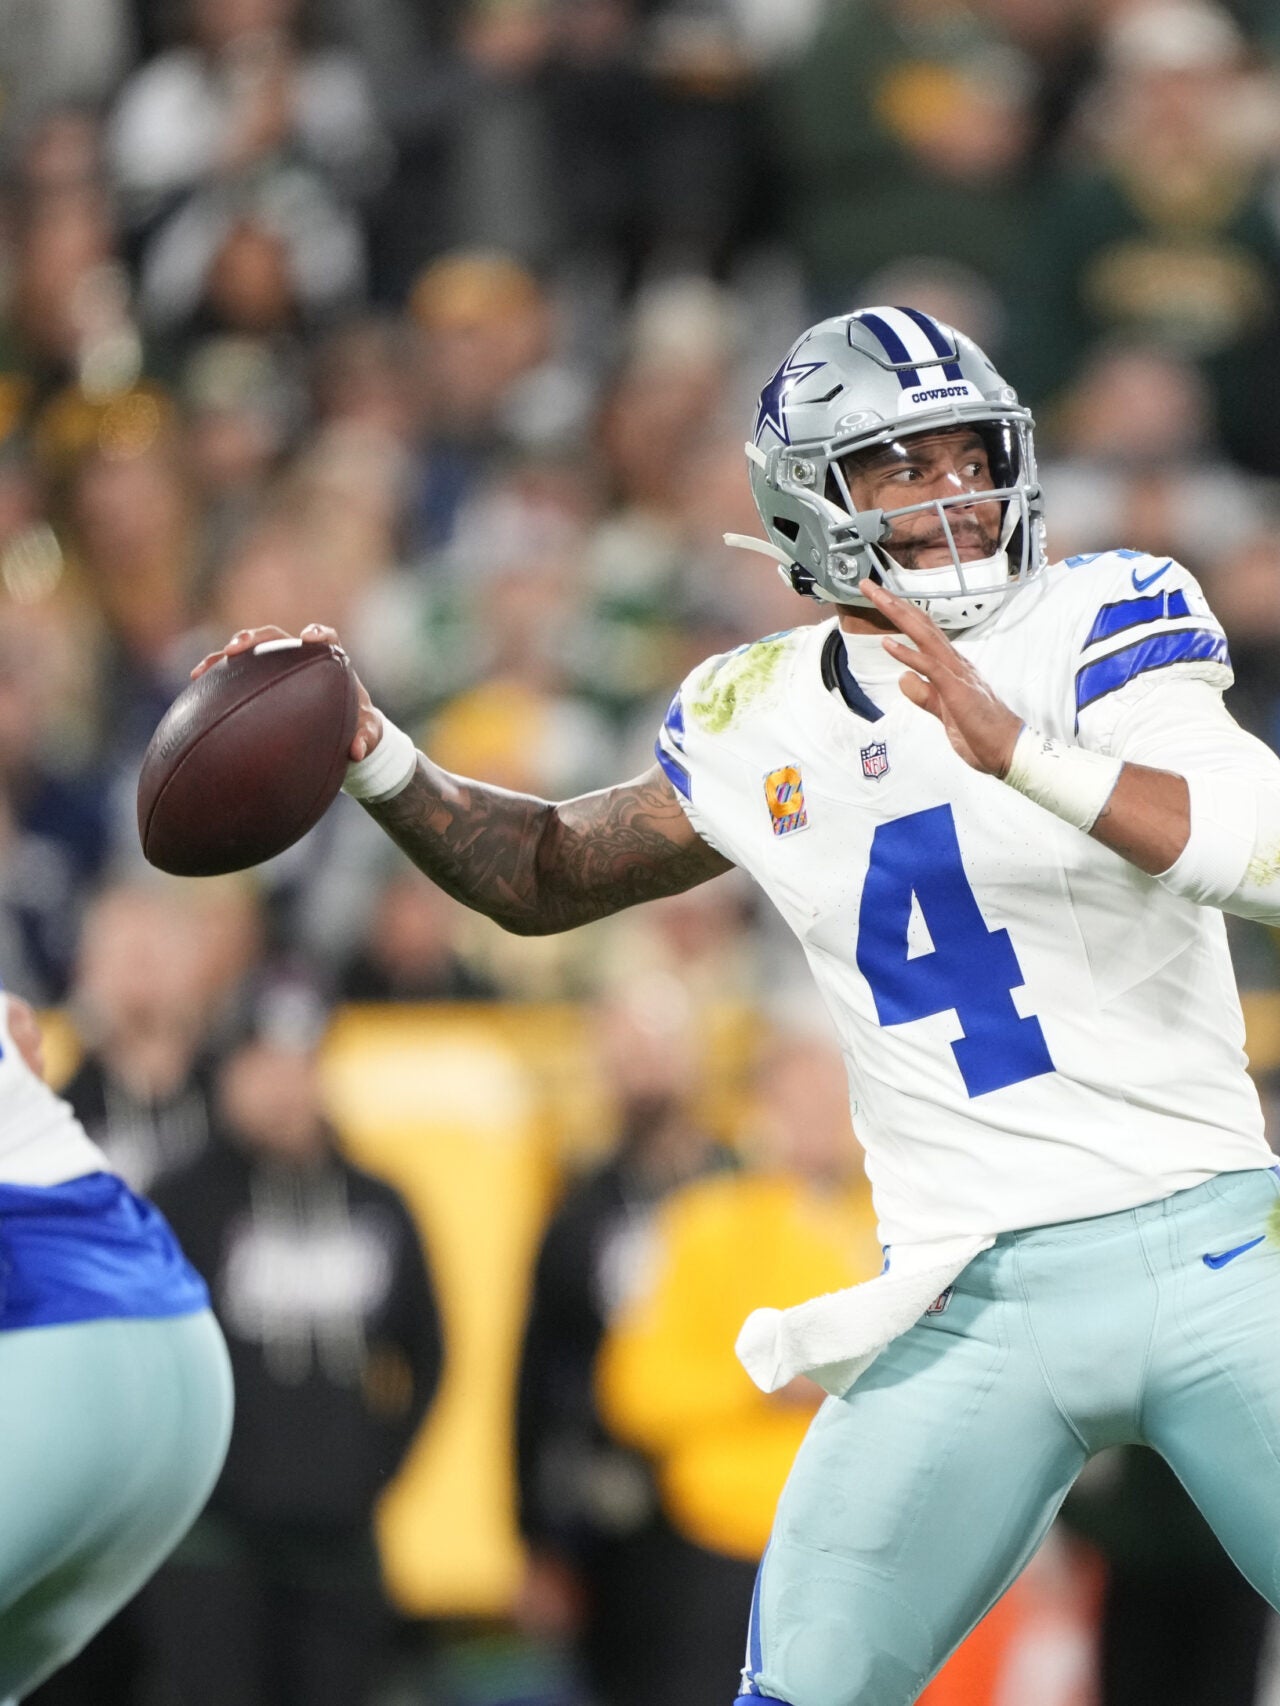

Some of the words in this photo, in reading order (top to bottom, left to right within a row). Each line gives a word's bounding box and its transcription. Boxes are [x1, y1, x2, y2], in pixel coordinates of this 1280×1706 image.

[911, 386, 969, 403] COWBOYS
[864, 756, 887, 776] NFL
[856, 802, 1057, 1099] 4
